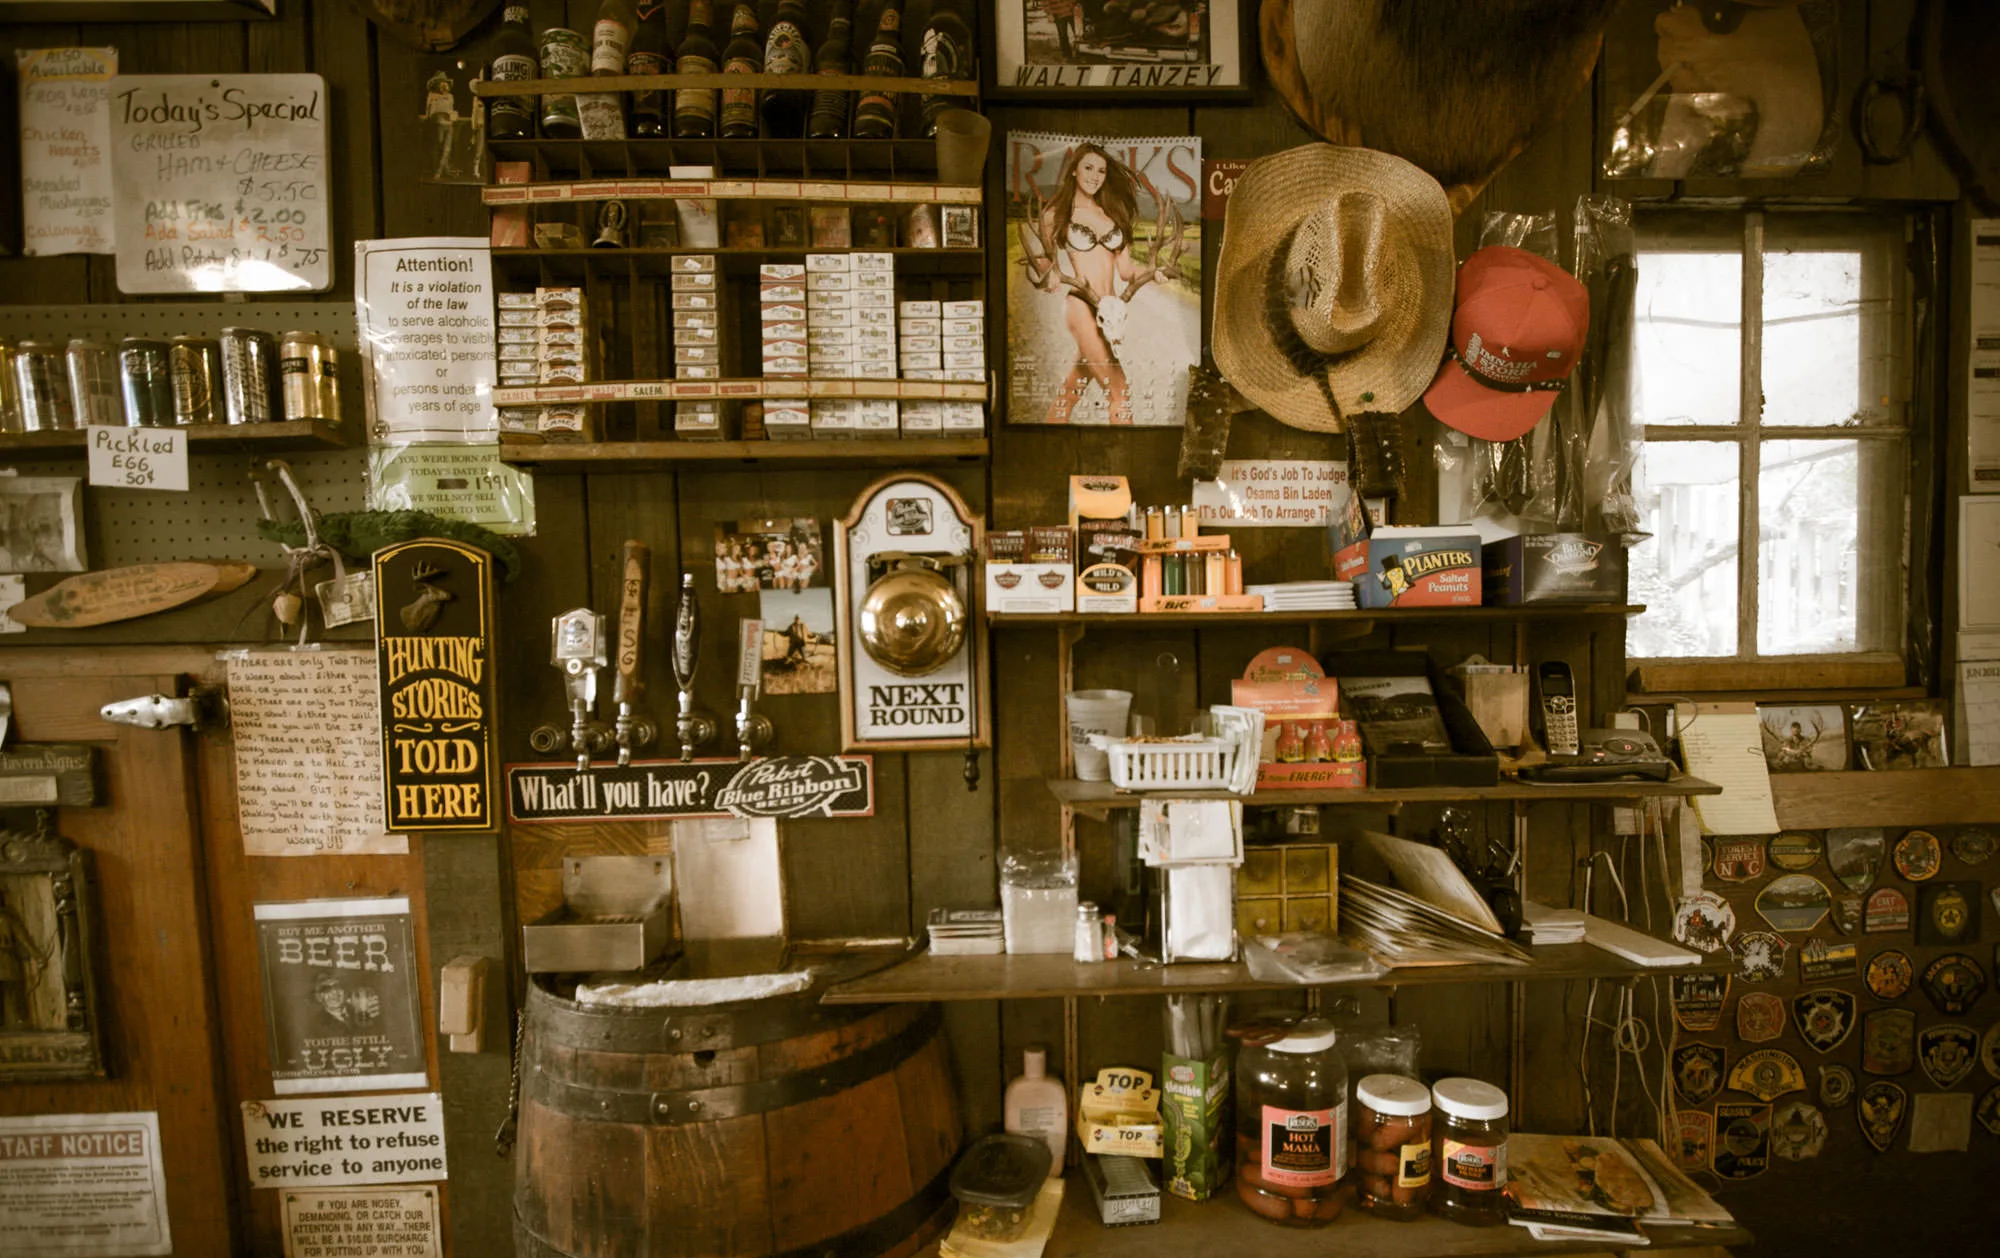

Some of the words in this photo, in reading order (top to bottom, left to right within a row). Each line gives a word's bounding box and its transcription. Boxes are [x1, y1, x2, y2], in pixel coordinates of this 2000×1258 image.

[1016, 66, 1091, 86] WALT
[1111, 65, 1222, 86] TANZEY
[118, 88, 220, 133] Today's
[223, 88, 320, 128] Special
[131, 134, 200, 151] GRILLED
[234, 149, 320, 175] CHEESE
[1012, 142, 1196, 203] RKS
[145, 200, 180, 221] Add
[144, 223, 179, 240] Add
[187, 218, 234, 241] Salad
[145, 249, 174, 271] Add
[396, 257, 474, 273] Attention!
[391, 282, 399, 293] It
[402, 282, 413, 293] is
[417, 284, 424, 292] a
[427, 281, 482, 293] violation
[407, 298, 418, 310] of
[423, 298, 443, 310] the
[446, 298, 468, 310] law
[388, 317, 399, 327] to
[402, 318, 434, 328] serve
[438, 316, 489, 327] alcoholic
[447, 334, 458, 344] to
[451, 350, 496, 363] persons
[436, 369, 447, 378] or
[393, 385, 439, 397] persons
[634, 386, 662, 396] SALEM
[409, 401, 440, 413] years
[444, 400, 456, 411] of
[460, 402, 481, 413] age
[96, 430, 174, 454] Pickled
[112, 455, 150, 472] EGG
[400, 455, 418, 463] YOU
[423, 455, 449, 463] WERE
[451, 454, 480, 463] BORN
[453, 468, 481, 476] DATE
[1231, 467, 1247, 481] It's
[1250, 467, 1277, 481] God's
[1281, 468, 1298, 480] Job
[1302, 468, 1313, 480] To
[1316, 468, 1346, 484] Judge
[1246, 487, 1280, 499] Osama
[1283, 487, 1299, 499] Bin
[1302, 487, 1332, 500] Laden
[460, 506, 473, 514] TO
[1262, 506, 1273, 519] To
[1276, 506, 1316, 521] Arrange
[1403, 551, 1473, 577] PLANTERS
[1439, 573, 1469, 583] Salted
[1095, 582, 1120, 591] MILD
[1427, 581, 1469, 592] Peanuts
[385, 637, 484, 686] HUNTING
[392, 678, 483, 719] STORIES
[869, 683, 964, 707] NEXT
[870, 707, 965, 726] ROUND
[395, 739, 478, 774] TOLD
[749, 760, 816, 786] Pabst
[1290, 770, 1333, 782] ENERGY
[518, 774, 596, 811] What'll
[602, 781, 640, 814] you
[648, 771, 710, 808] have?
[722, 788, 766, 806] Blue
[767, 777, 853, 800] Ribbon
[396, 783, 481, 819] HERE
[278, 927, 300, 936] BUY
[304, 927, 325, 936] ME
[327, 923, 386, 935] ANOTHER
[277, 934, 395, 973] BEER
[352, 1035, 391, 1046] STILL
[301, 1045, 394, 1070] UGLY
[1107, 1073, 1145, 1089] TOP
[267, 1112, 304, 1129] WE
[321, 1106, 428, 1126] RESERVE
[256, 1138, 289, 1154] the
[294, 1135, 343, 1155] right
[349, 1134, 371, 1150] to
[376, 1132, 440, 1149] refuse
[1118, 1130, 1143, 1141] TOP
[1289, 1132, 1316, 1142] HOT
[0, 1135, 53, 1157] TAFF
[61, 1133, 142, 1156] NOTICE
[1282, 1141, 1321, 1152] MAMA
[258, 1160, 333, 1179] service
[341, 1159, 363, 1174] to
[371, 1157, 443, 1175] anyone
[329, 1200, 347, 1209] YOU
[351, 1200, 369, 1209] ARE
[356, 1211, 369, 1220] OR
[372, 1210, 400, 1220] CATCH
[405, 1210, 423, 1219] OUR
[293, 1223, 340, 1233] ATTENTION
[344, 1223, 353, 1232] IN
[356, 1222, 375, 1232] ANY
[322, 1235, 333, 1245] BE
[337, 1235, 344, 1244] A
[377, 1233, 429, 1243] SURCHARGE
[304, 1247, 322, 1257] FOR
[326, 1246, 363, 1257] PUTTING
[366, 1246, 378, 1256] UP
[381, 1245, 401, 1255] WITH
[406, 1245, 424, 1255] YOU
